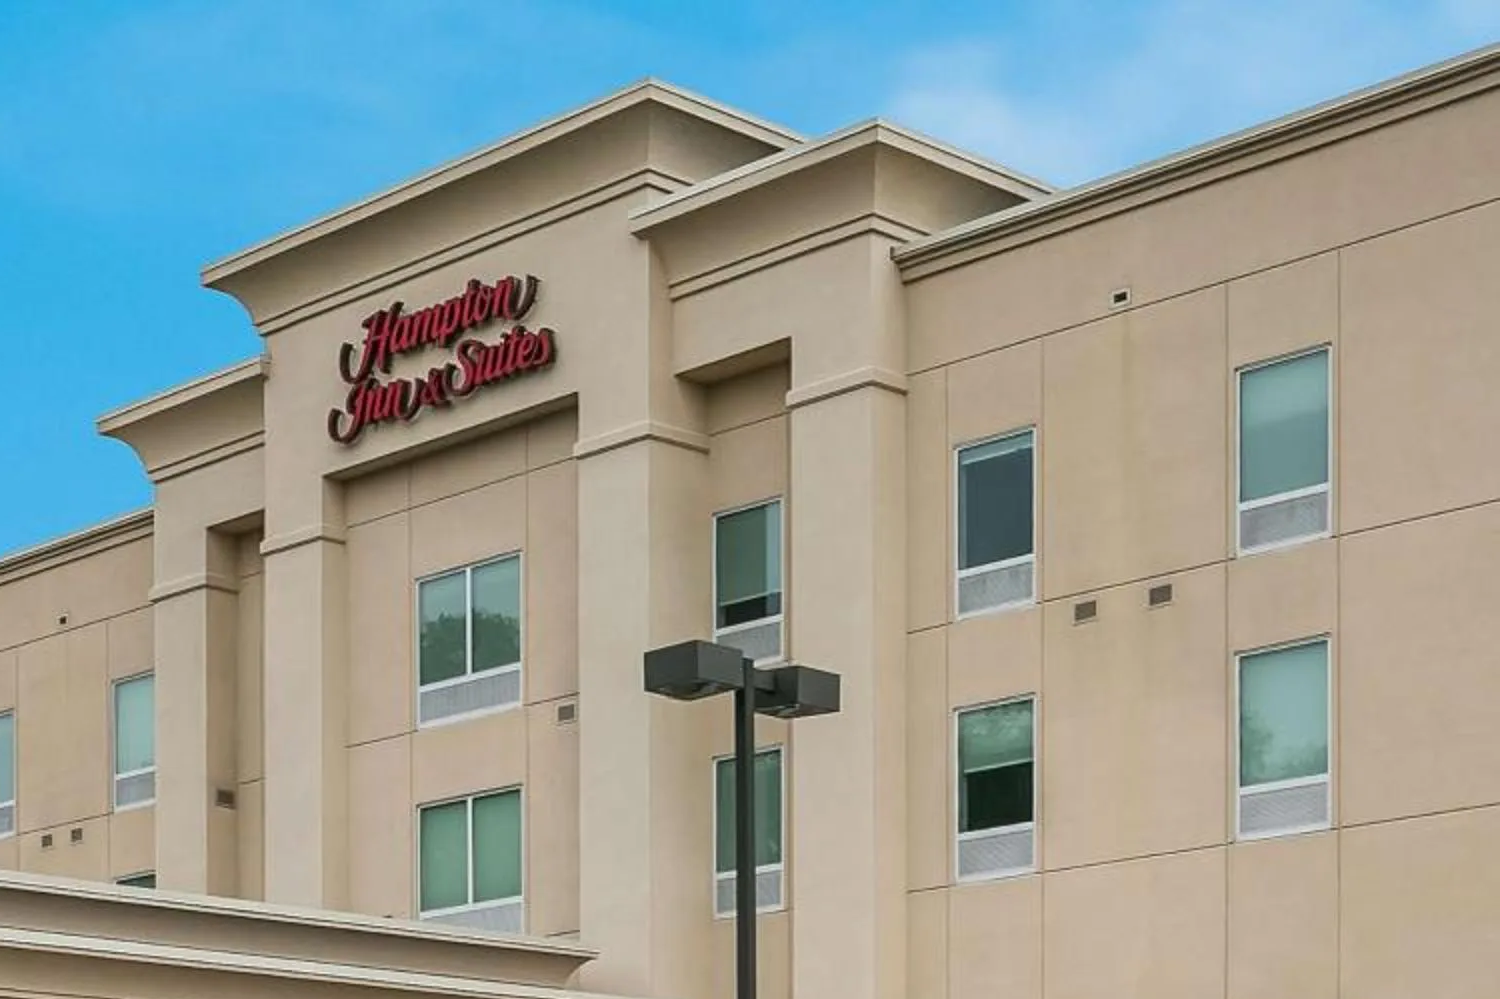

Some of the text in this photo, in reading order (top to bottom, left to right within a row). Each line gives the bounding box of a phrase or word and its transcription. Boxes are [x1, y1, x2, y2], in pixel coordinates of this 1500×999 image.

[327, 325, 558, 445] Inn & Suites
[339, 274, 540, 385] Hampton
